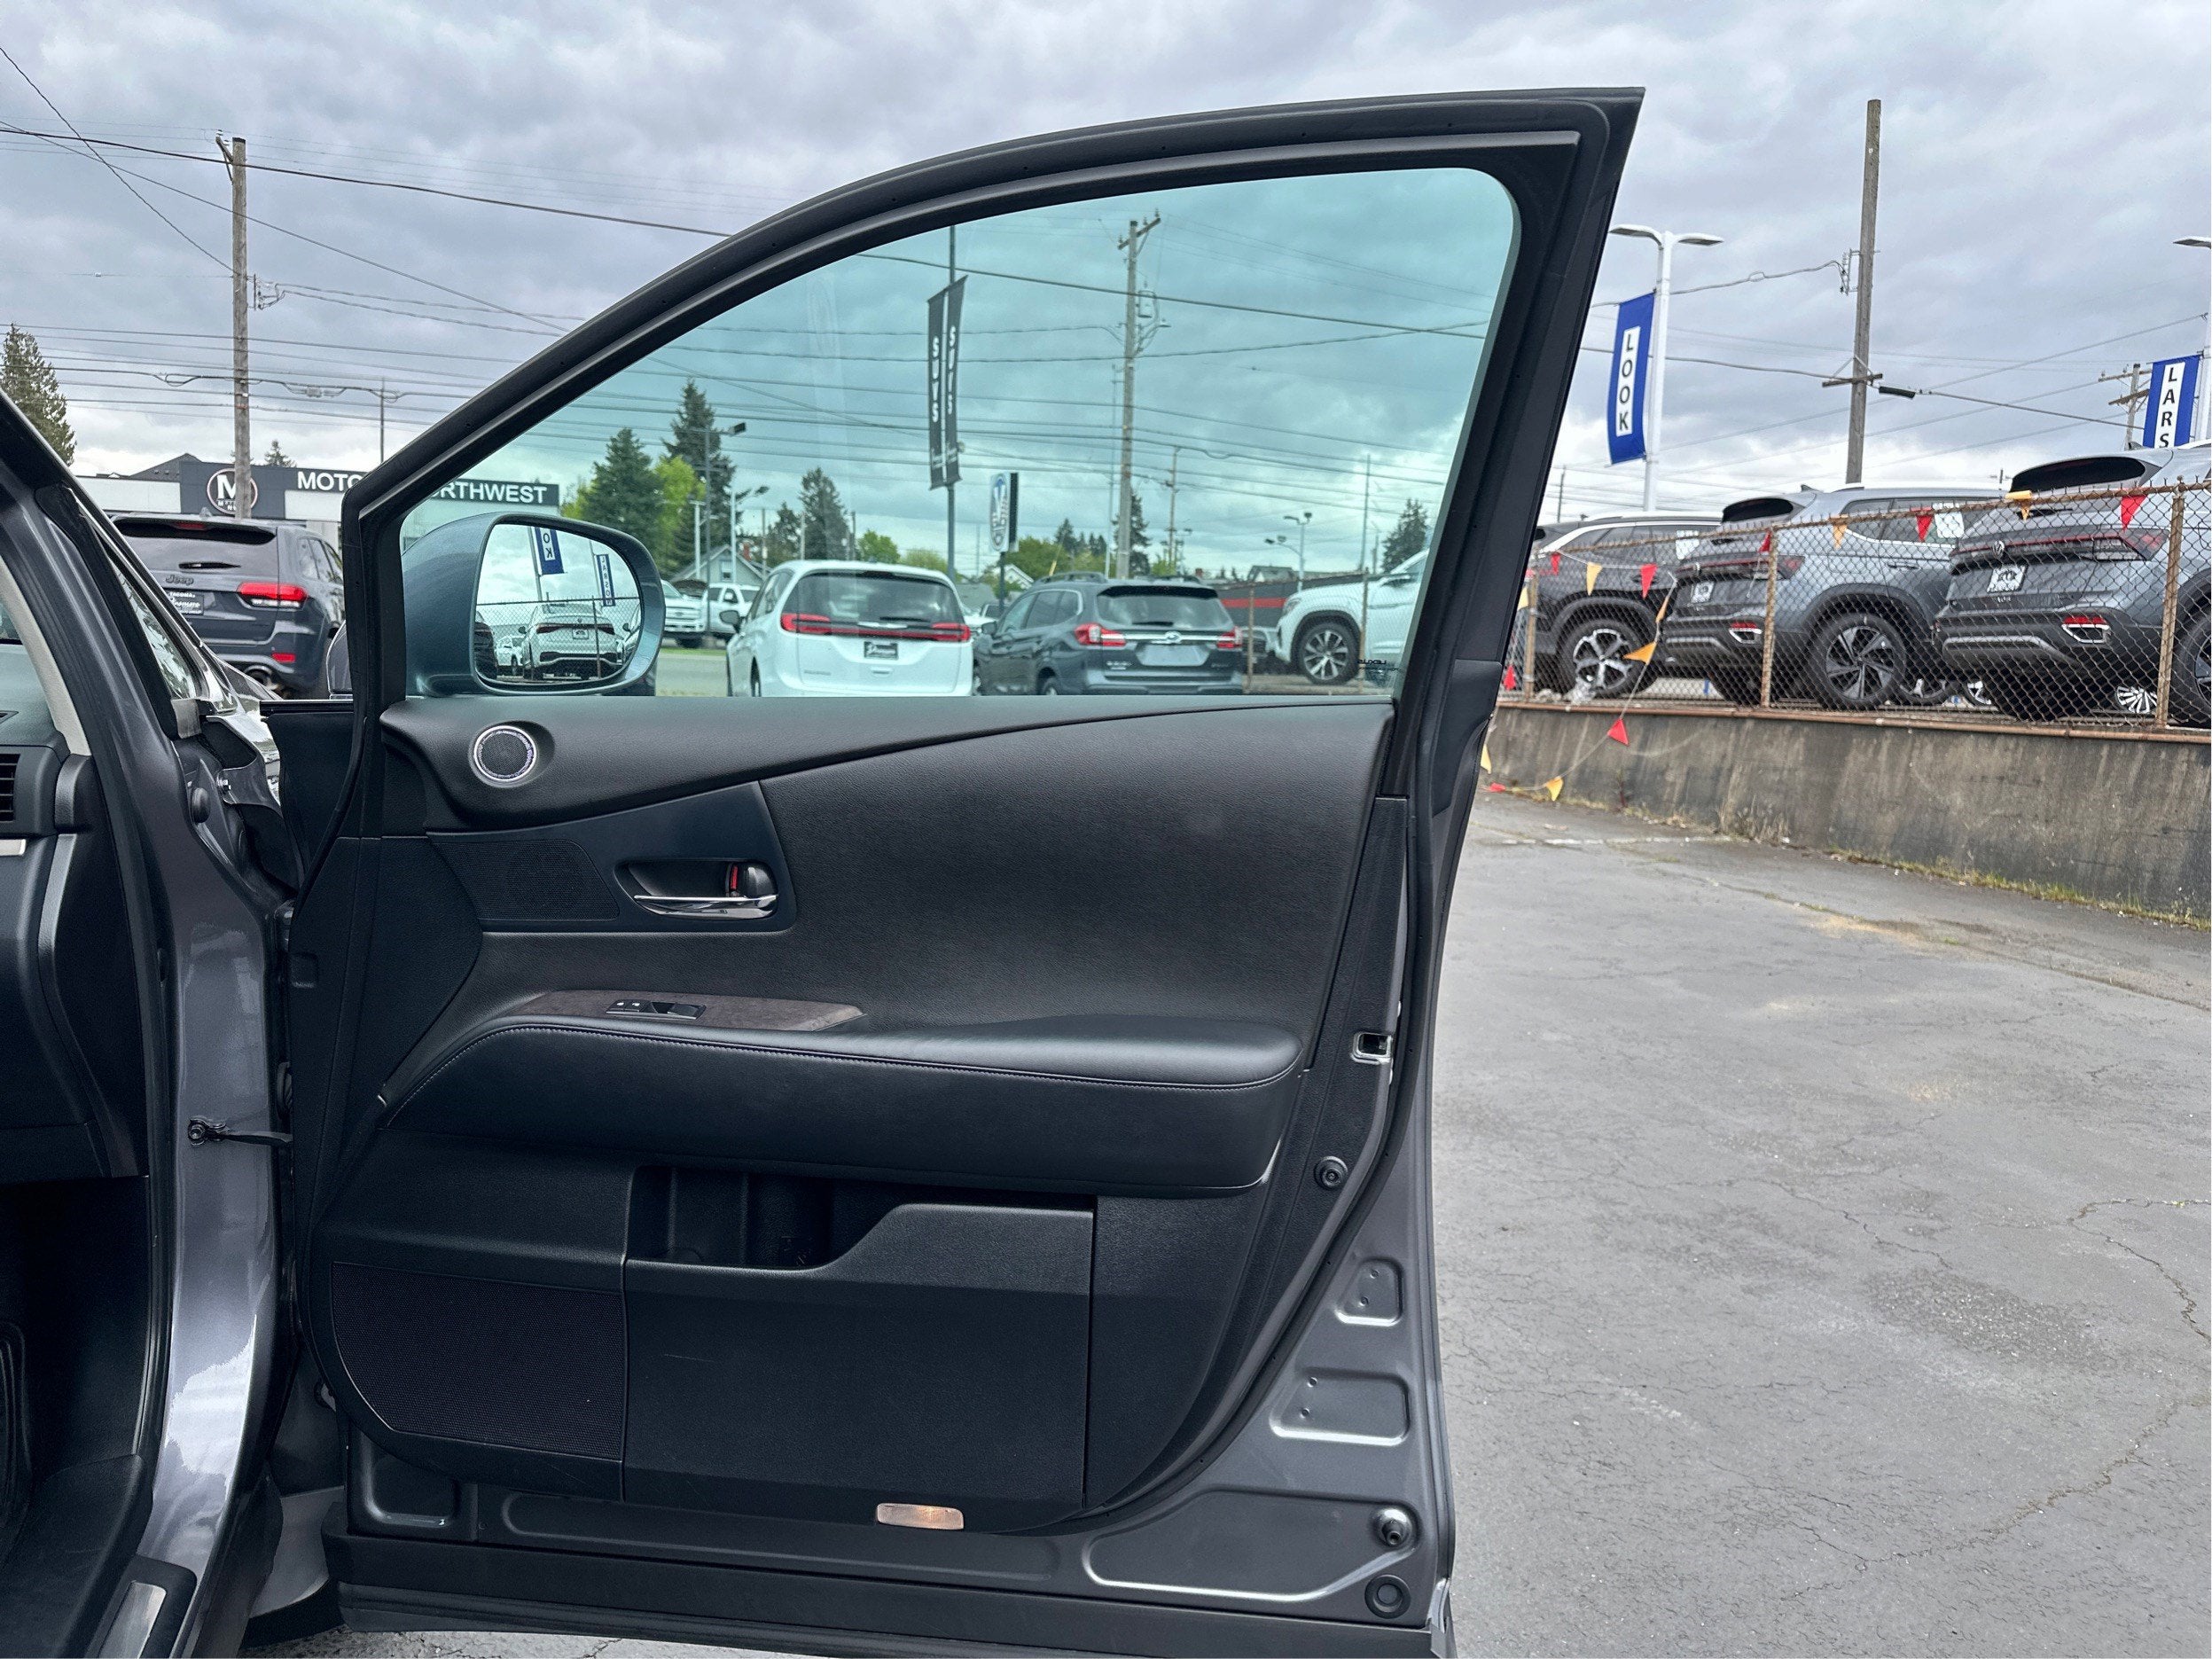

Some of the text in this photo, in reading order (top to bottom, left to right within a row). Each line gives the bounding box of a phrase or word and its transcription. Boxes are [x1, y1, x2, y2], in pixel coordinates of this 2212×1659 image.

[1619, 333, 1633, 431] LOOK
[2159, 366, 2177, 449] LARS
[297, 471, 547, 504] MOTO RTHWEST
[165, 574, 194, 586] Jeep
